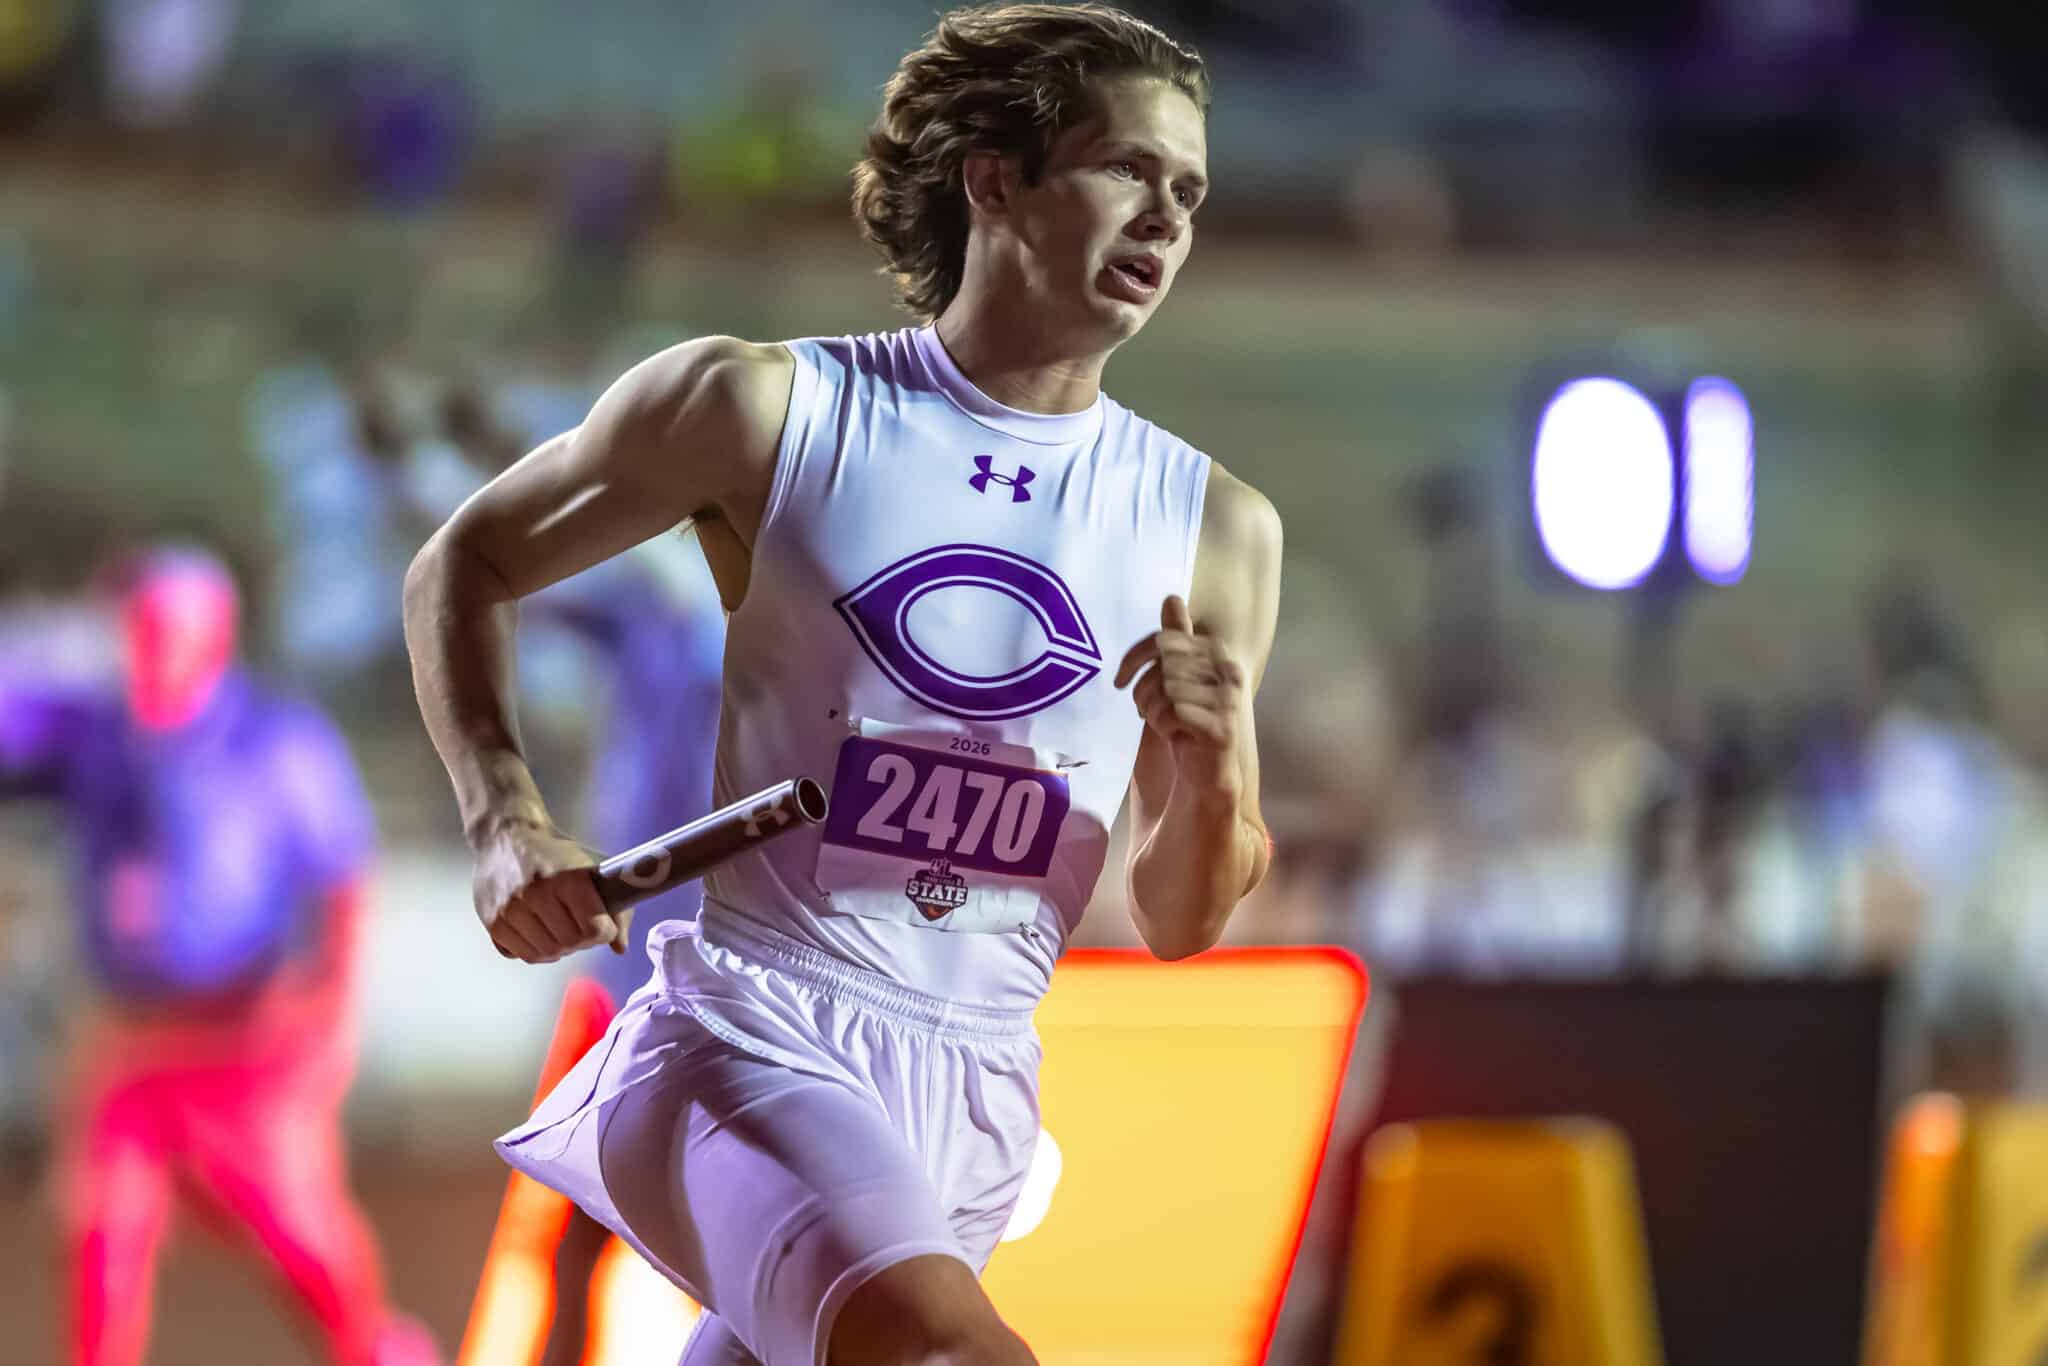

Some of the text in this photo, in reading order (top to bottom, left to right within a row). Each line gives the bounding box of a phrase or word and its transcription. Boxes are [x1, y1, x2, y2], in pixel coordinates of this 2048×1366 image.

[832, 543, 1102, 721] C
[950, 737, 991, 756] 2026
[856, 754, 1046, 863] 2470
[907, 880, 967, 902] STATE
